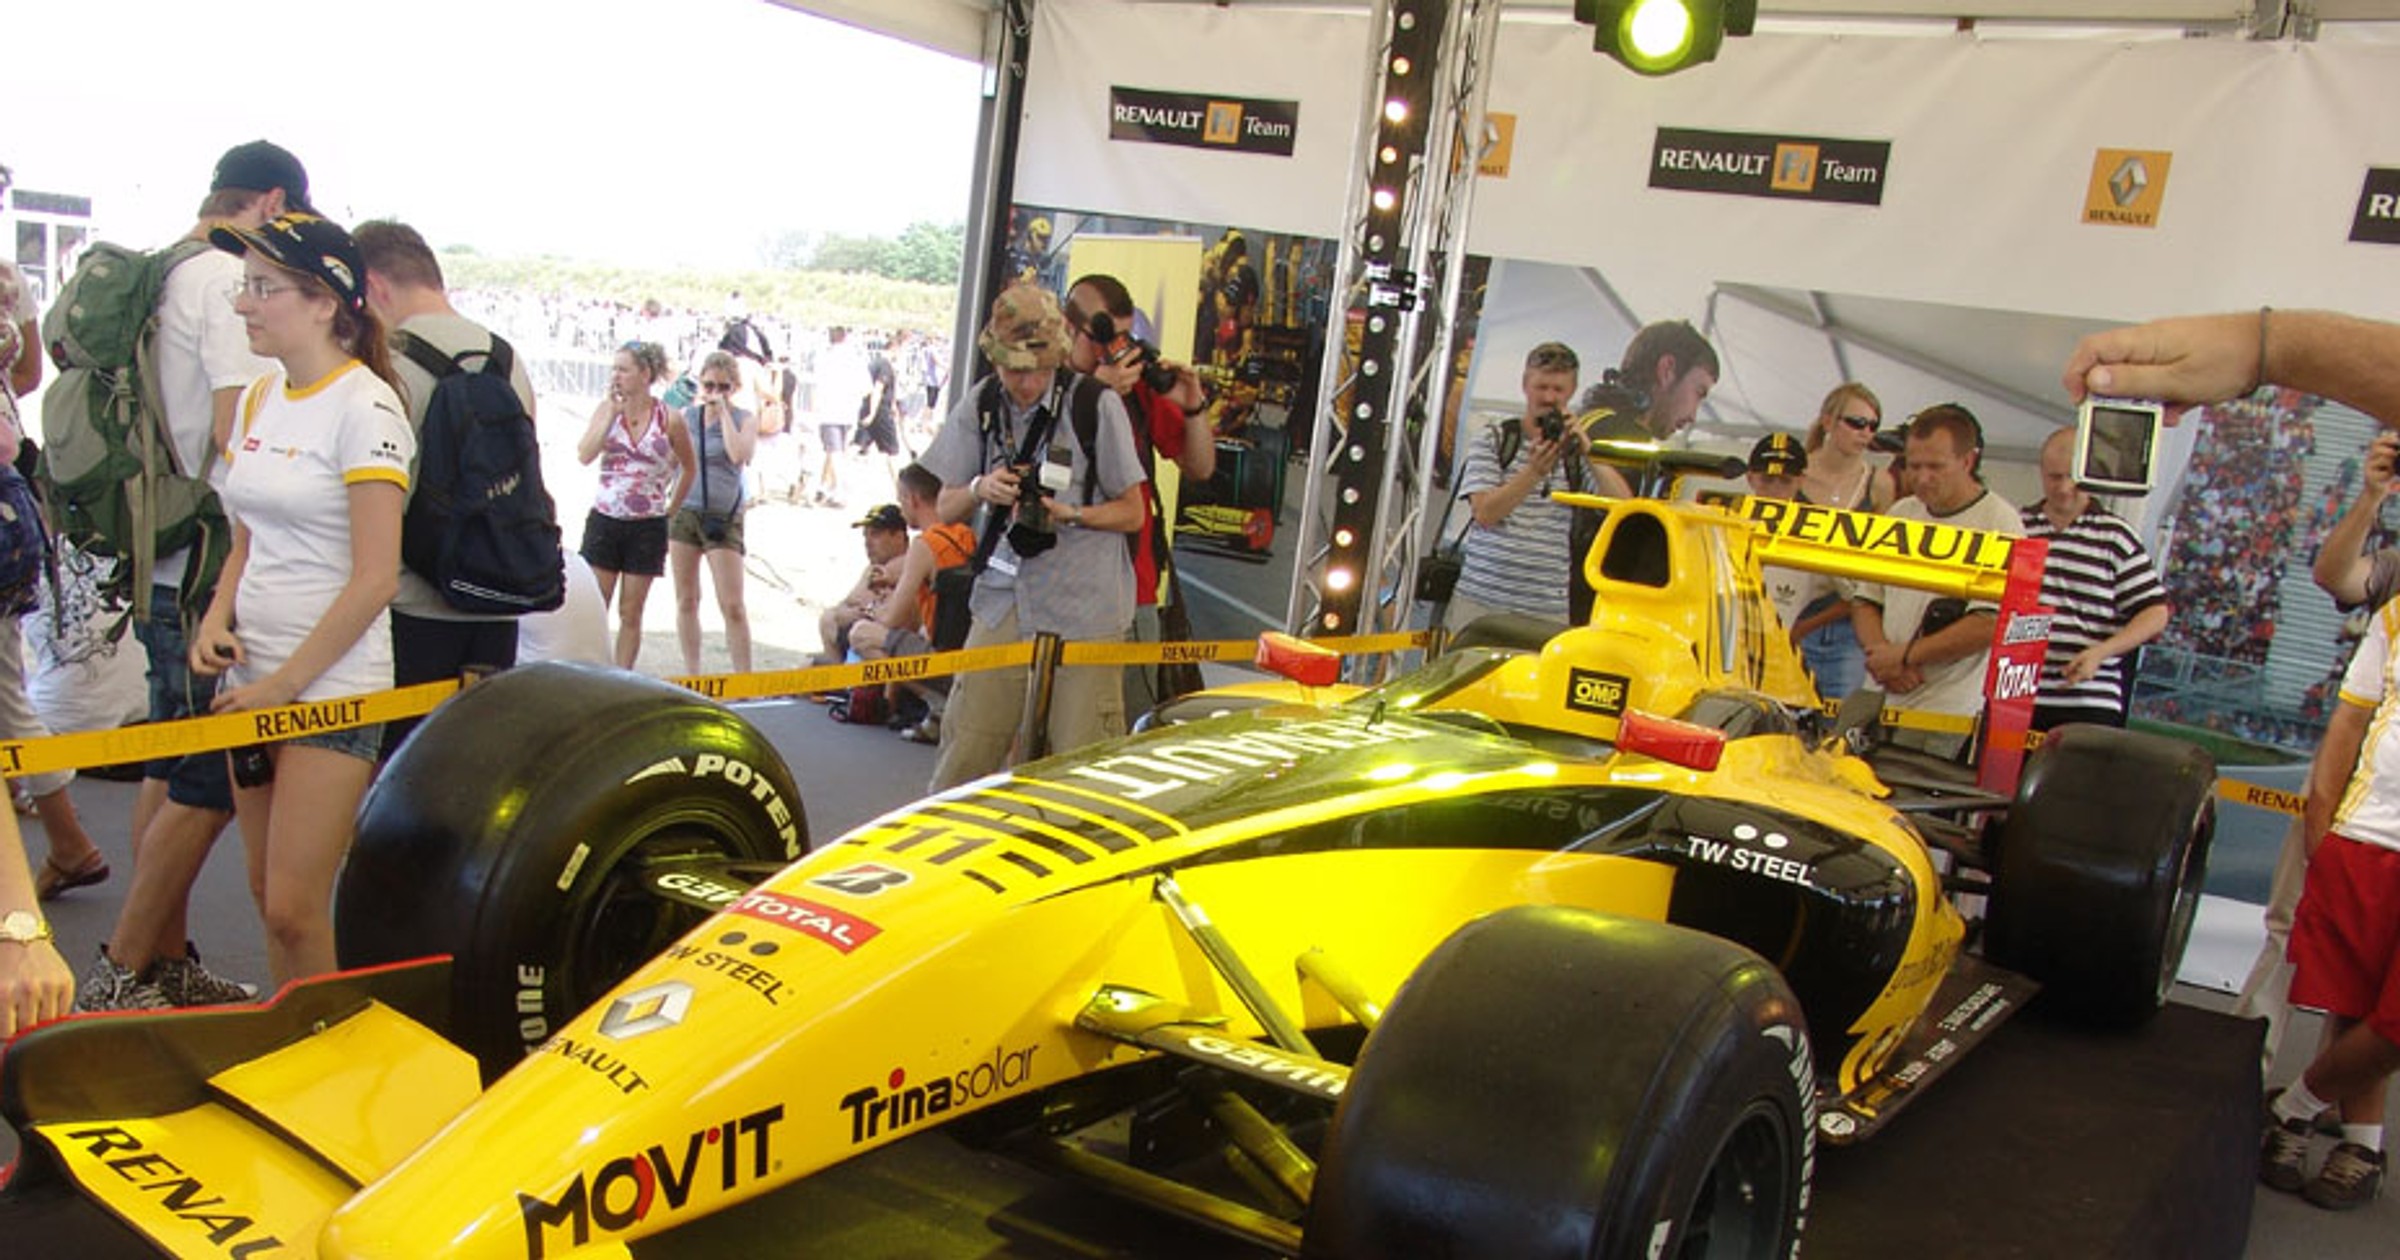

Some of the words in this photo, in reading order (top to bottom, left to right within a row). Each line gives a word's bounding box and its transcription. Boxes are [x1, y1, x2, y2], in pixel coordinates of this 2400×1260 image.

[1114, 103, 1204, 130] RENAULT
[1245, 116, 1290, 139] Team
[1659, 148, 1769, 176] RENAULT
[1822, 159, 1878, 183] Team
[2368, 193, 2400, 219] R
[1749, 500, 2015, 570] RENAULT
[861, 656, 931, 683] RENAULT
[1994, 656, 2039, 700] TOTAL
[1576, 682, 1621, 704] OMP
[254, 700, 366, 738] RENAULT
[1687, 834, 1729, 864] TW
[1731, 847, 1814, 887] STEEL
[743, 894, 854, 946] TOTAL
[695, 951, 784, 1006] STEEL
